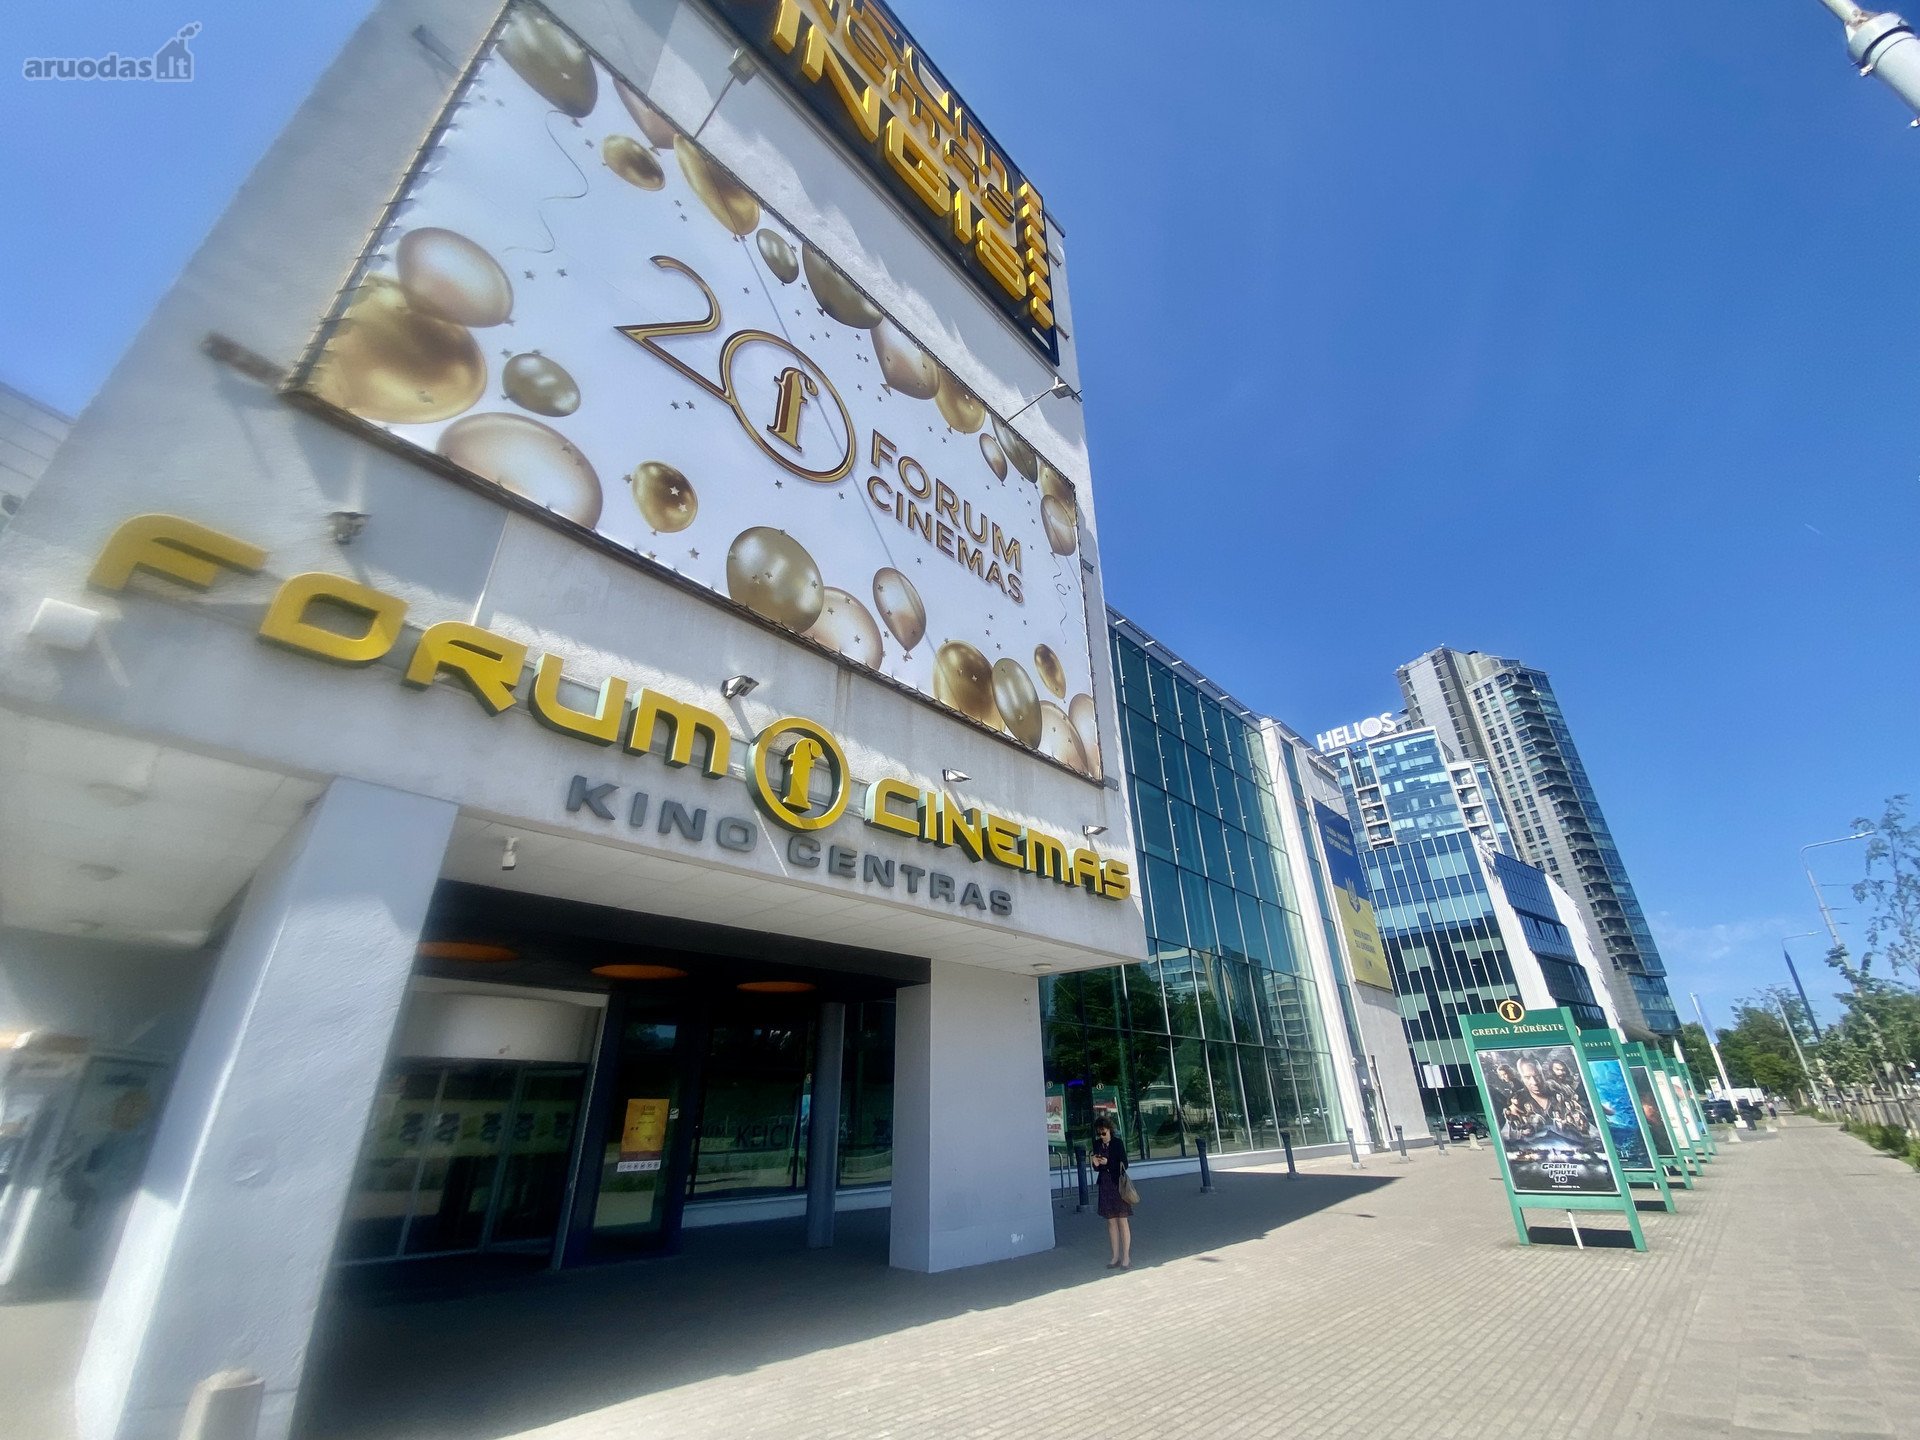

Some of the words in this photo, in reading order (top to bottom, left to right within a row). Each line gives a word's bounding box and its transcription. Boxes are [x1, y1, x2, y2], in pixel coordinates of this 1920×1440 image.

[867, 476, 1025, 604] CINEMAS
[871, 429, 1022, 573] FORUM
[87, 513, 732, 780] FORUM
[865, 777, 1131, 902] CINEMAS
[1316, 712, 1396, 752] HELIOS
[565, 774, 758, 852] KINO
[788, 834, 1013, 917] CENTRAS
[1471, 1027, 1510, 1037] GREITAI
